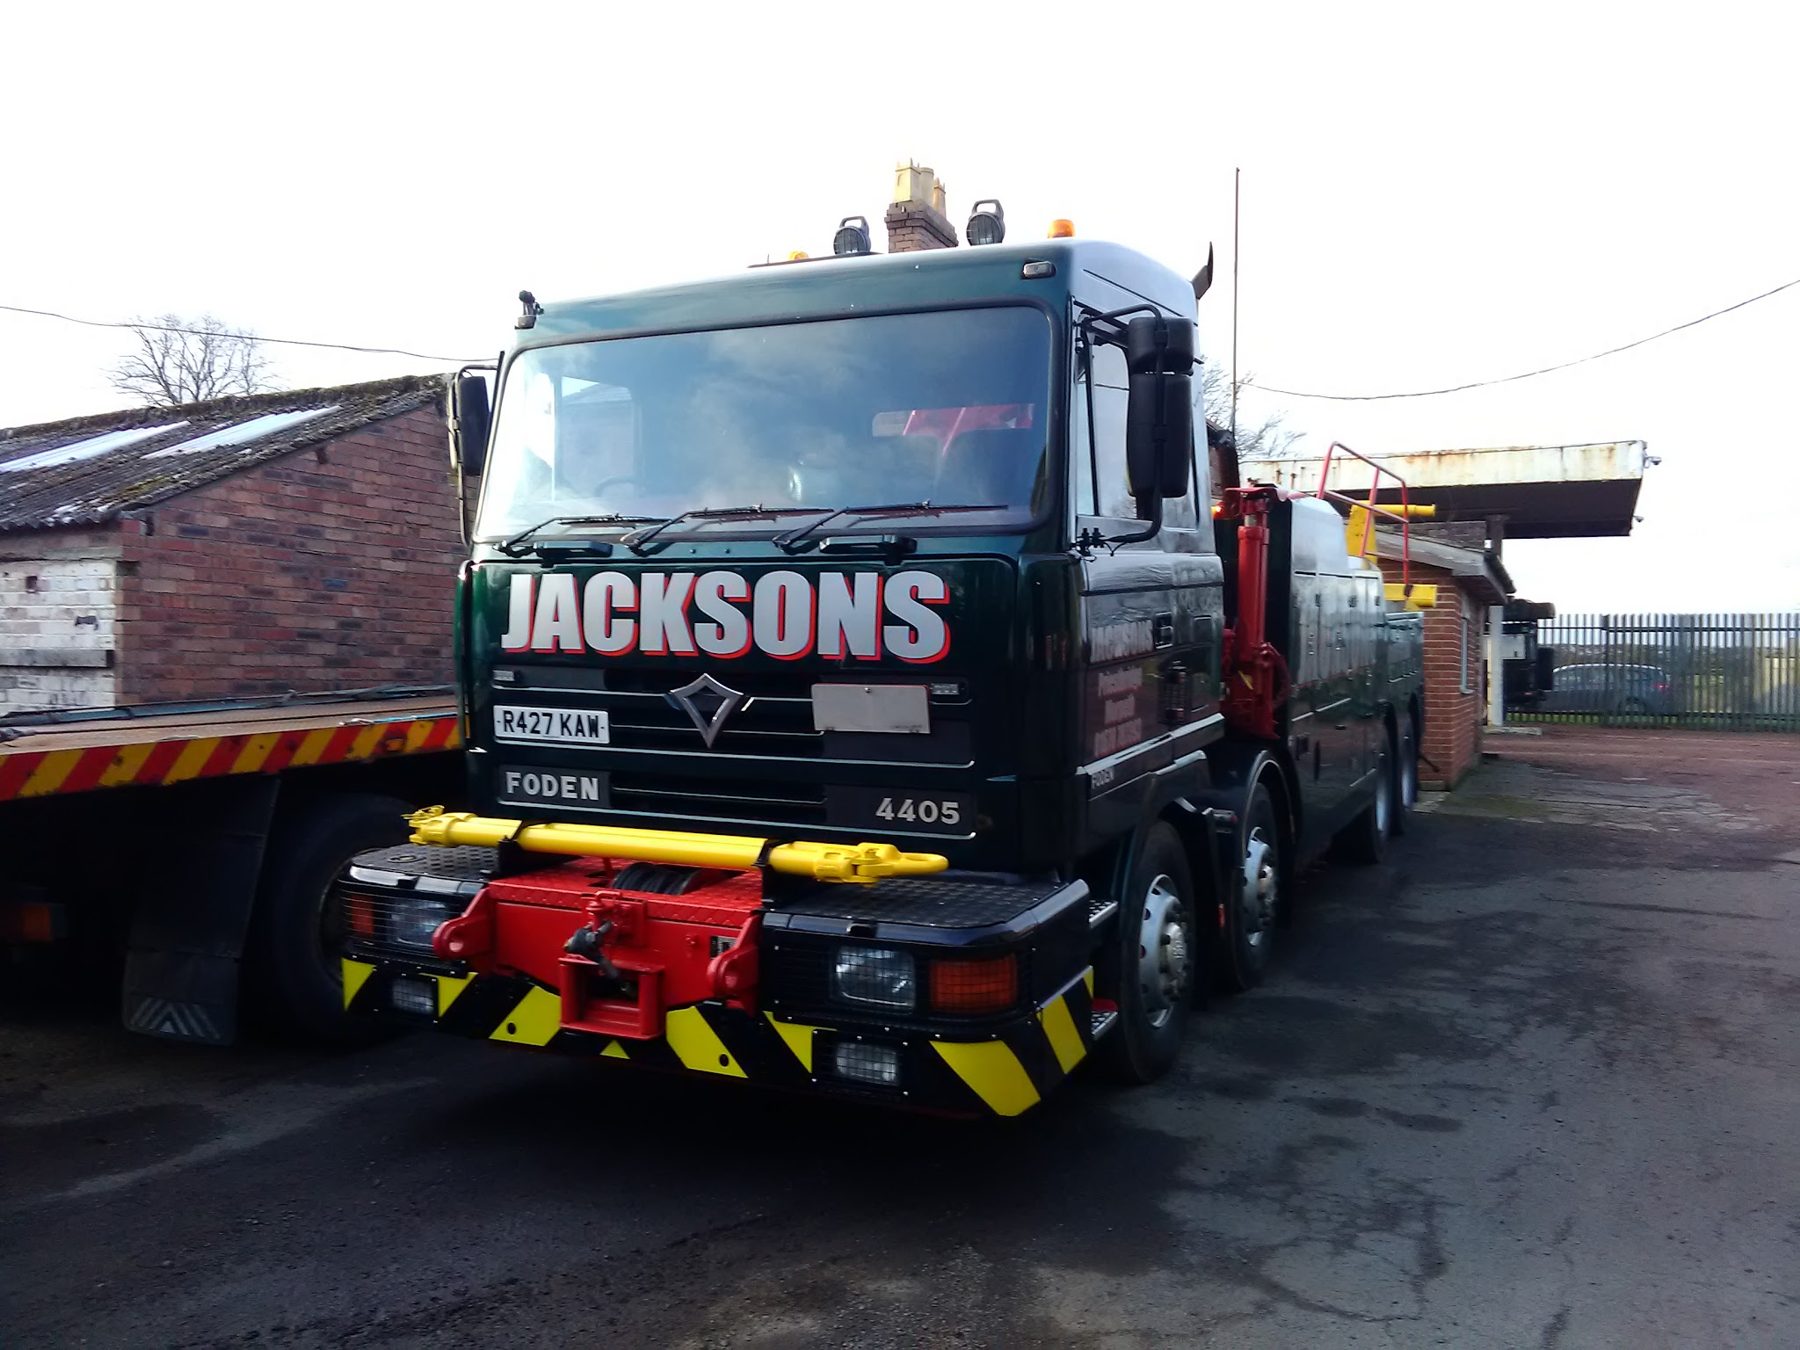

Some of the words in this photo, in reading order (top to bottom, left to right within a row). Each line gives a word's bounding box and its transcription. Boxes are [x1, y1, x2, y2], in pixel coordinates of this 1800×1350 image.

[501, 570, 950, 663] JACKSONS
[503, 710, 553, 735] R427
[560, 713, 599, 738] KAW
[506, 771, 599, 801] FODEN
[875, 797, 960, 825] 4405
